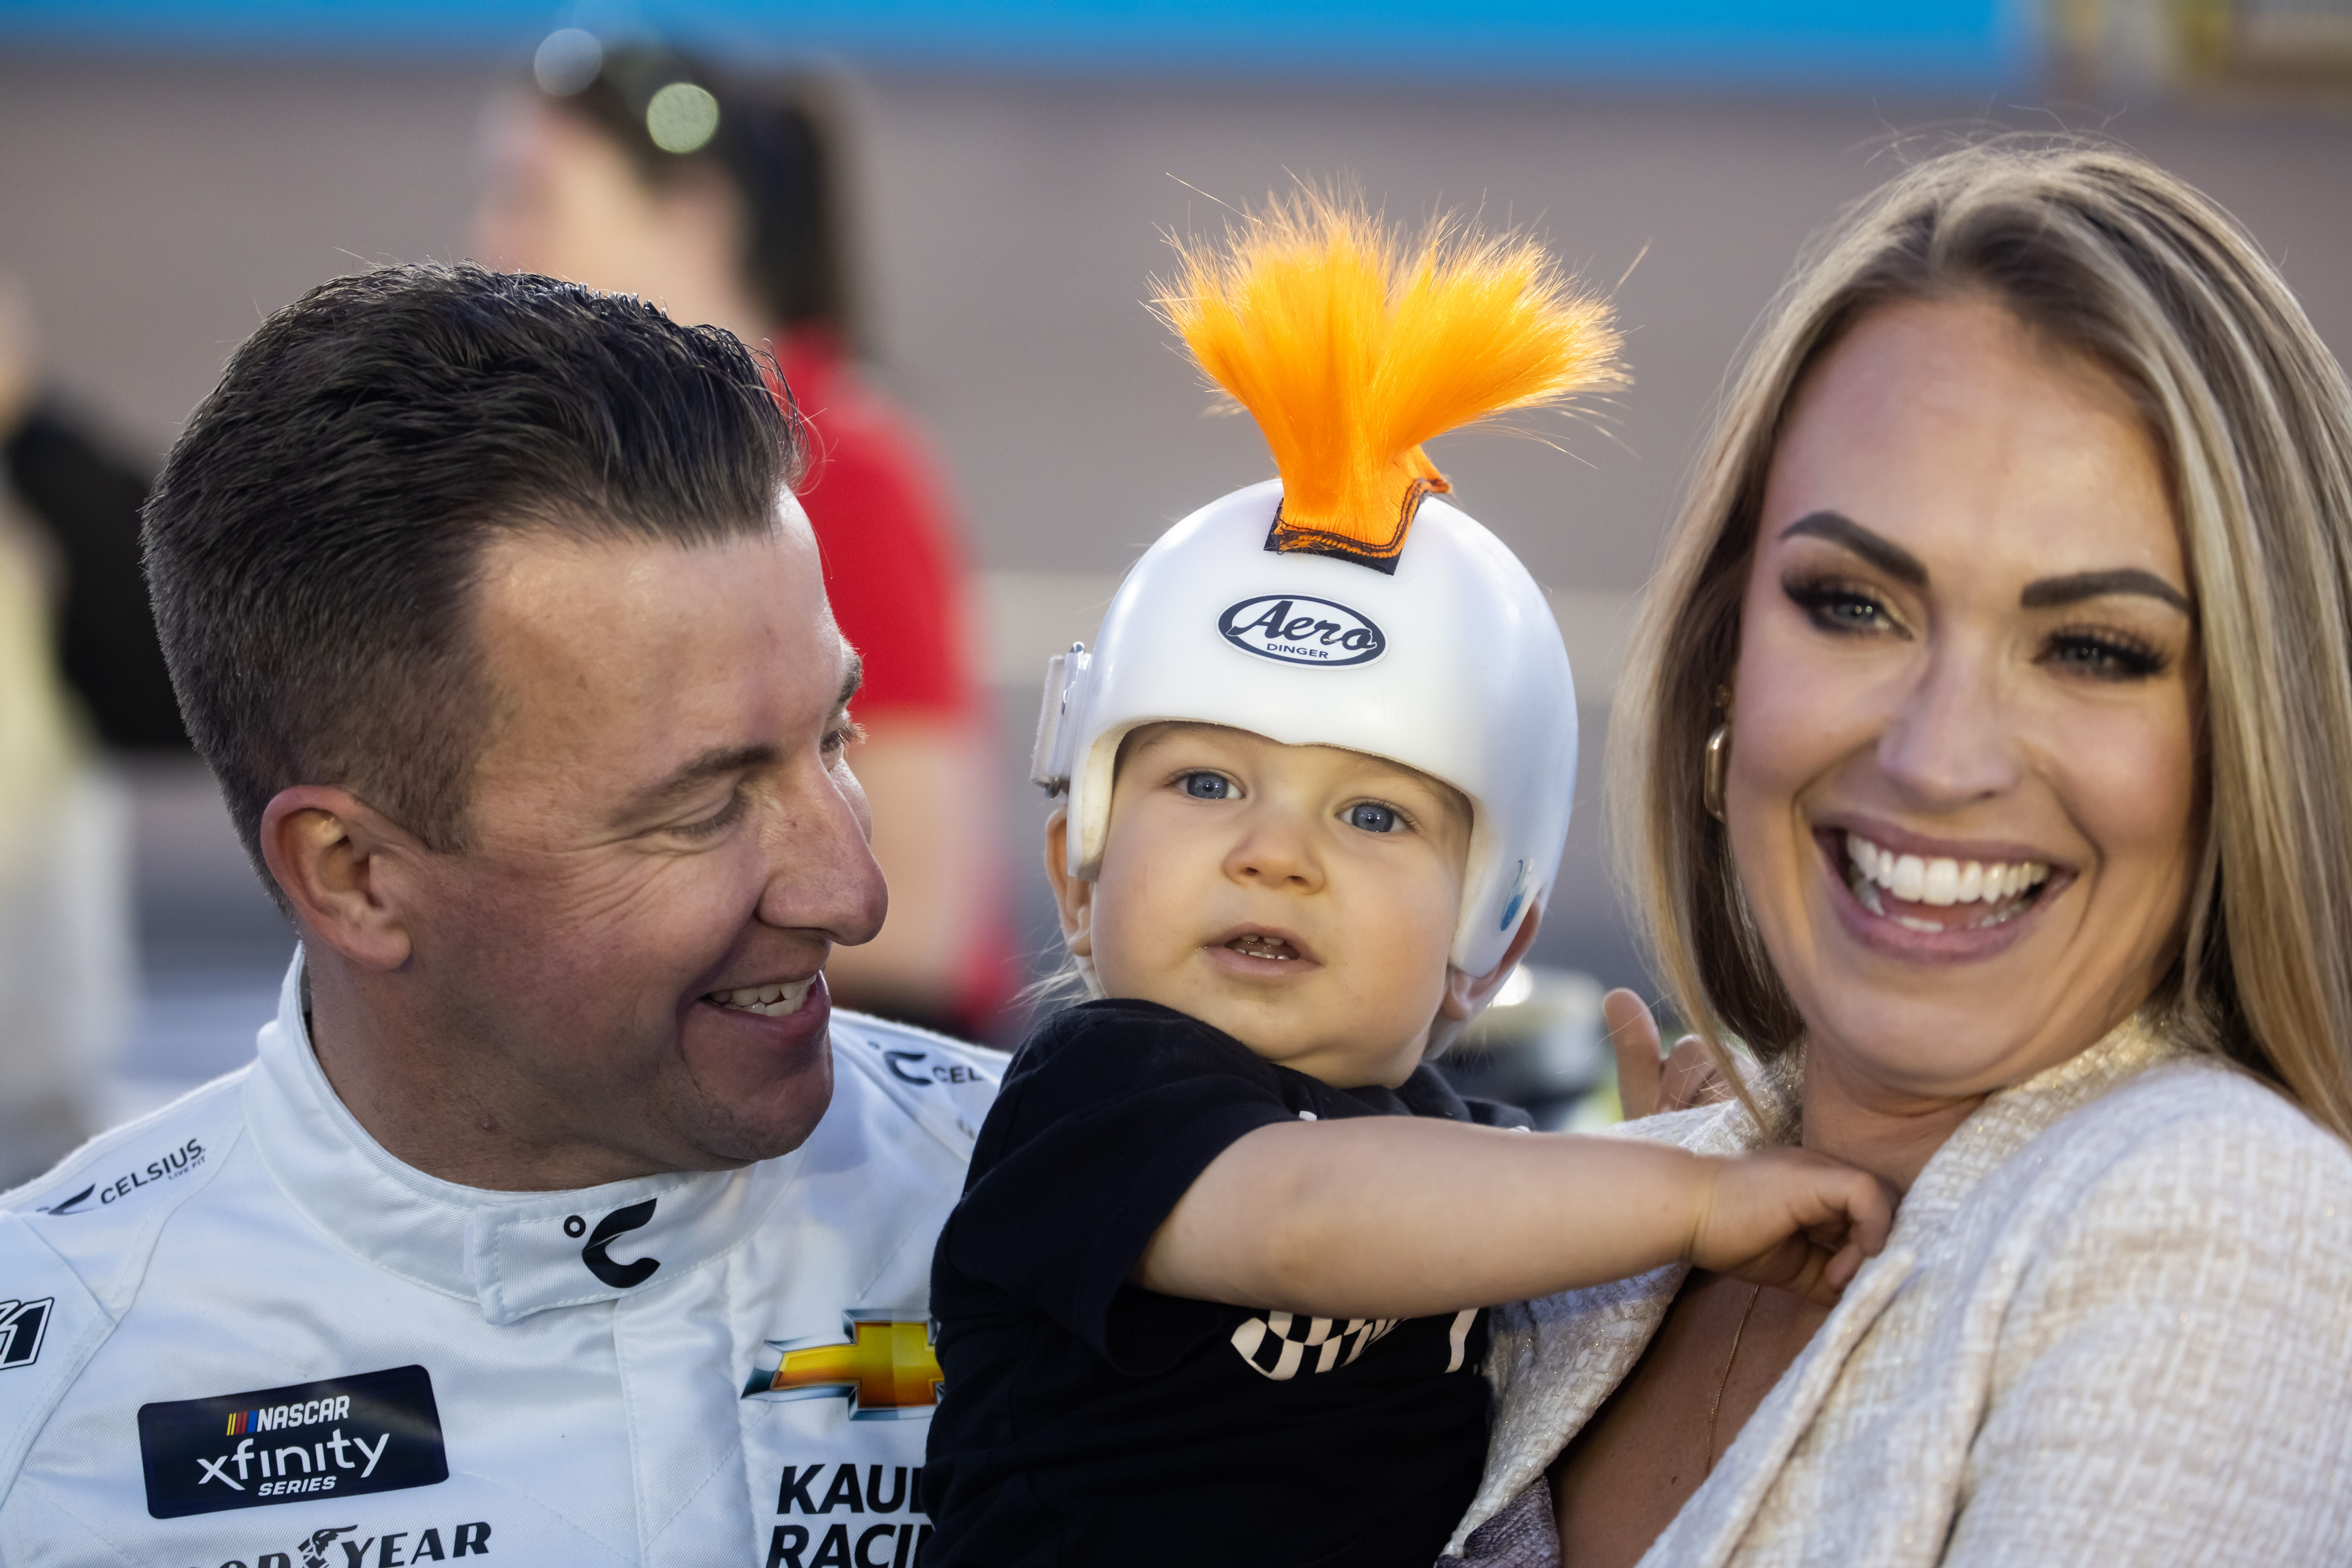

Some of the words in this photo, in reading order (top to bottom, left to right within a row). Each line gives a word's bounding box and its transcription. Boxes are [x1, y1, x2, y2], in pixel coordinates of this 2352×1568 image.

[1226, 600, 1377, 651] Aero
[1267, 643, 1328, 659] DINGER
[100, 1138, 202, 1205] CELSIUS
[169, 1168, 189, 1180] LIVE
[192, 1156, 205, 1169] FIT
[256, 1395, 350, 1432] NASCAR
[196, 1428, 390, 1491] xfinity
[258, 1475, 337, 1497] SERIES
